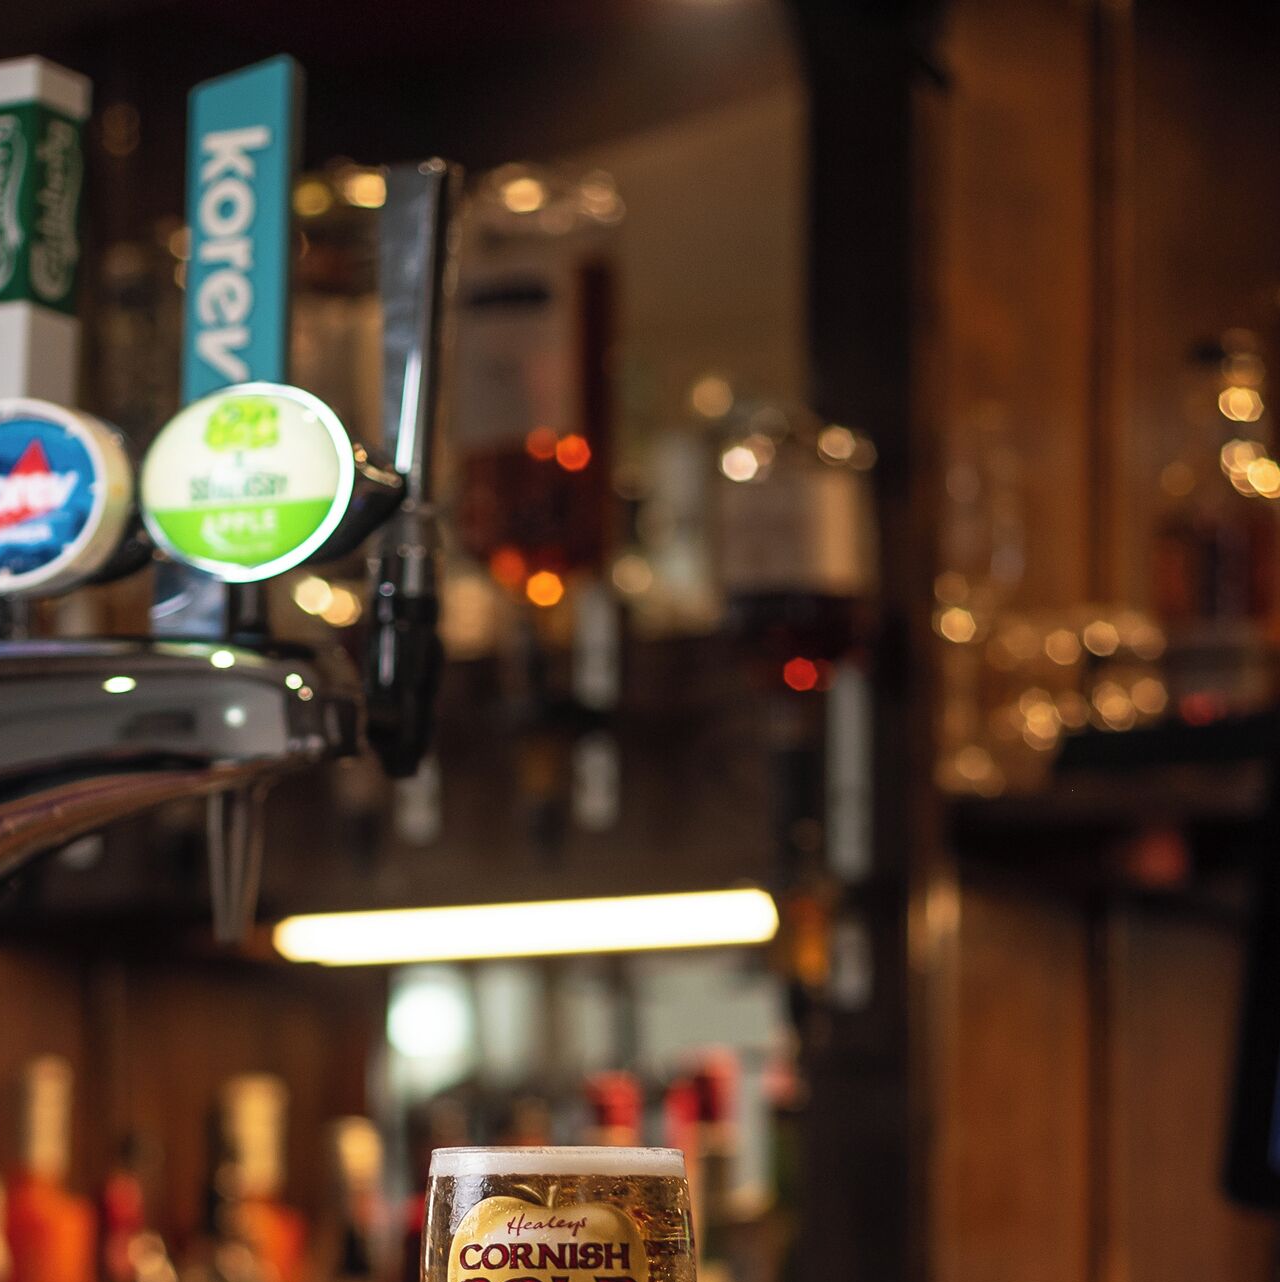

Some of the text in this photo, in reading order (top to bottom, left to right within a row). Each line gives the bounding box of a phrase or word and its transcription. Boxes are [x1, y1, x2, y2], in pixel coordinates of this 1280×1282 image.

[196, 126, 271, 383] korev
[507, 1213, 587, 1237] Healeys
[459, 1242, 630, 1270] CORNISH
